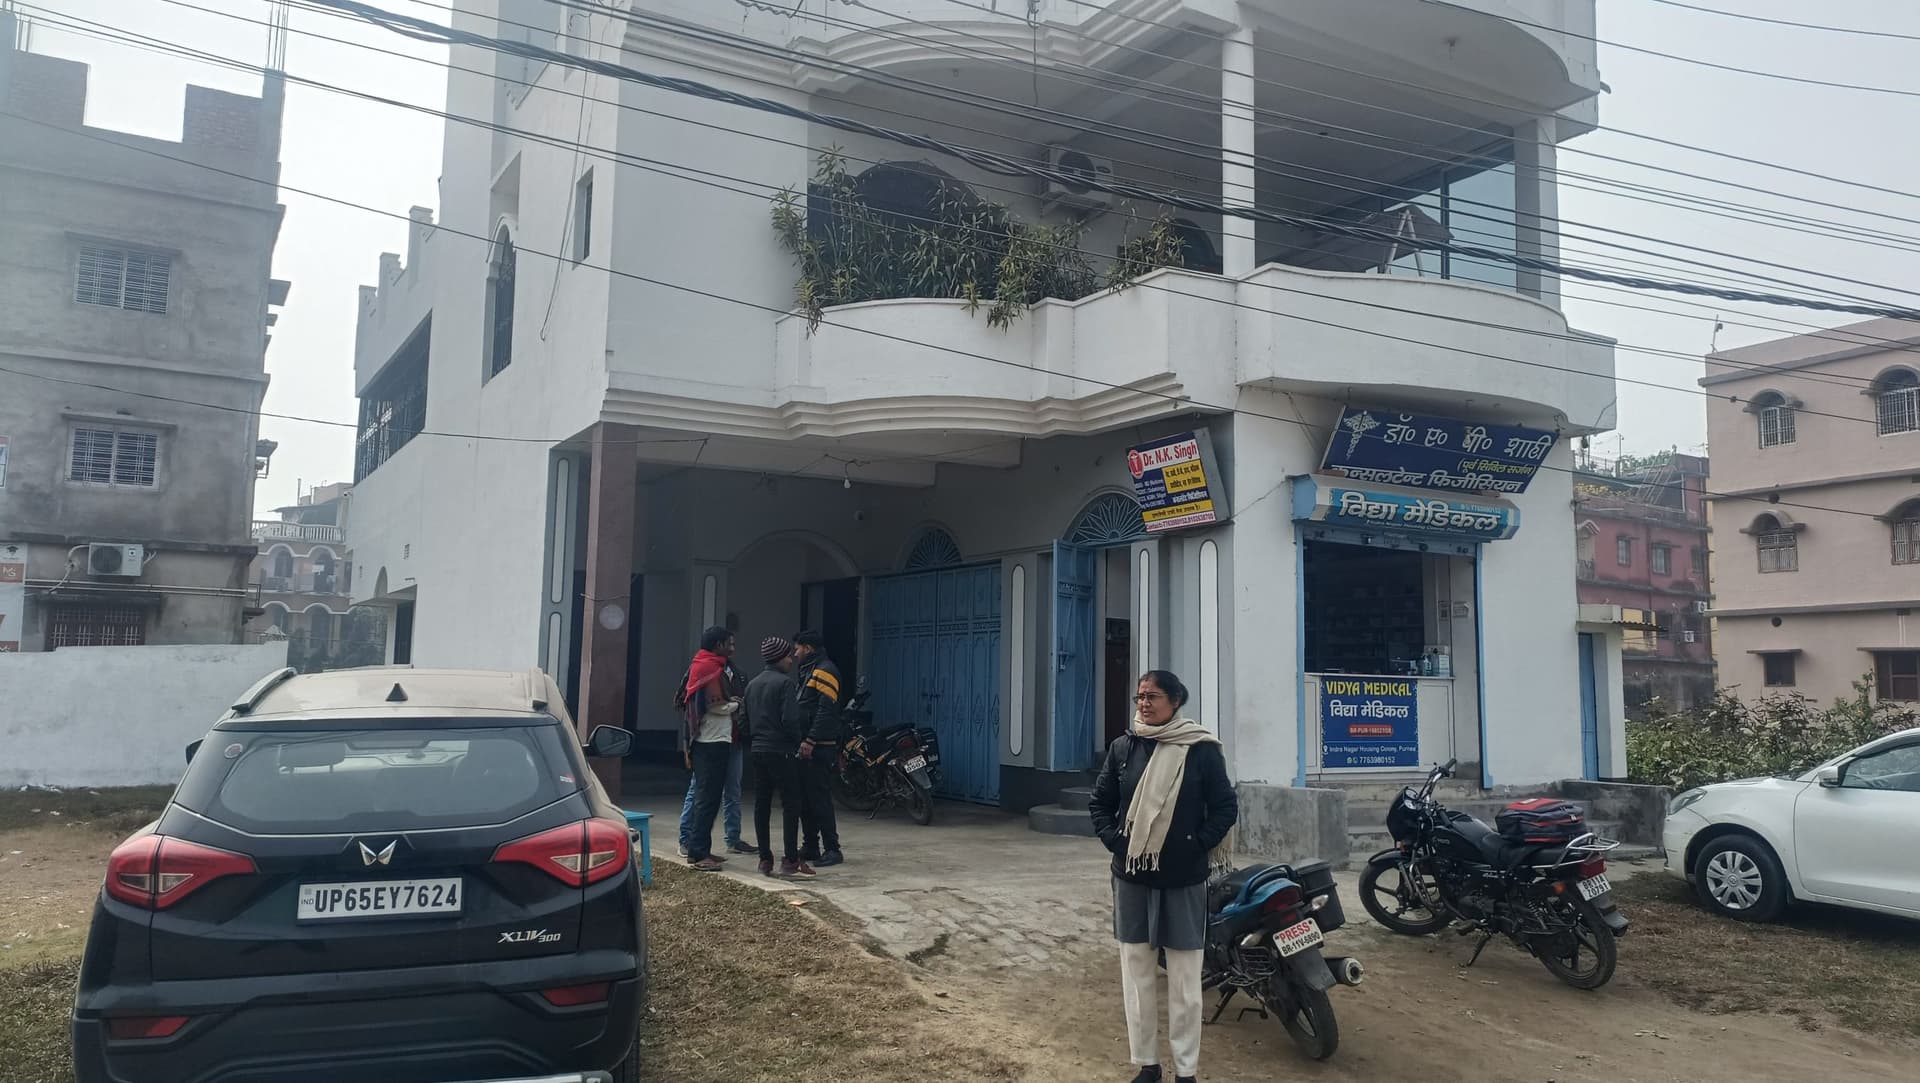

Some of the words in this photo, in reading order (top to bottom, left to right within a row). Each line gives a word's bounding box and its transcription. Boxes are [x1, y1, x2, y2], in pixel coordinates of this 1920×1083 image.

[1143, 454, 1154, 466] Dr.
[1156, 447, 1172, 463] N.K.
[1175, 442, 1197, 460] Singh
[1339, 491, 1398, 521] विद्या
[1403, 499, 1501, 531] मेडिकल
[1326, 681, 1360, 696] VIDYA
[1363, 681, 1412, 697] MEDICAL
[1330, 699, 1358, 718] विद्या
[1360, 700, 1410, 718] मेडिकल
[315, 883, 457, 913] UP65EY7624
[1279, 921, 1311, 944] PRESS
